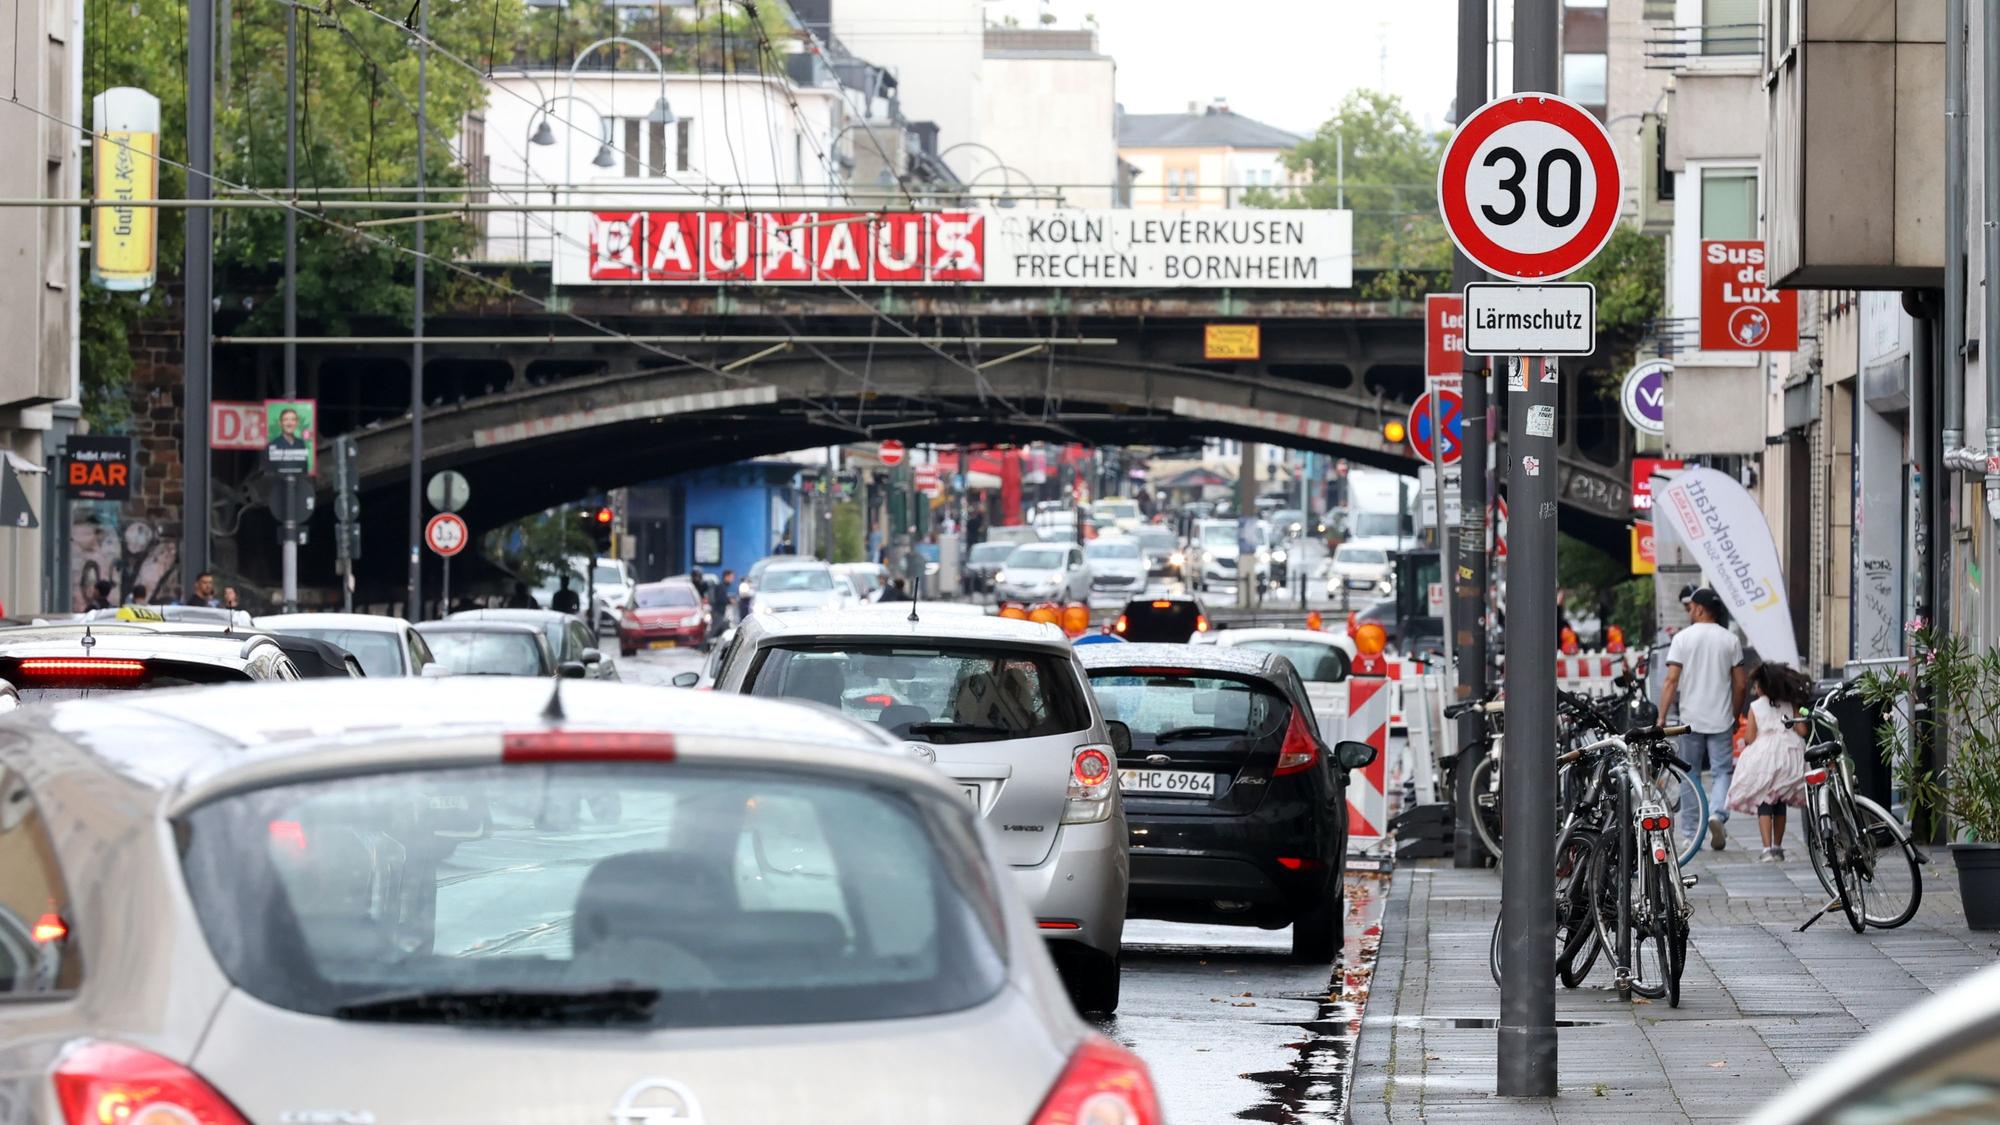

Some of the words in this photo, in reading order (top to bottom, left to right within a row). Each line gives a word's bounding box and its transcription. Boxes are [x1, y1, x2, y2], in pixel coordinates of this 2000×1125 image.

[1480, 146, 1582, 228] 30
[113, 187, 133, 236] Gafel
[1029, 213, 1102, 243] KÖLN
[1131, 220, 1304, 244] LEVERKUSEN
[597, 219, 976, 272] BAUHAUS
[1707, 244, 1764, 265] Sus
[1016, 255, 1138, 279] FRECHEN
[1166, 255, 1318, 280] BORNHEIM
[1723, 282, 1781, 303] Lux
[1476, 308, 1582, 330] Lärmschutz
[70, 462, 128, 487] BAR
[1138, 772, 1161, 789] HC
[1166, 773, 1211, 793] 6964
